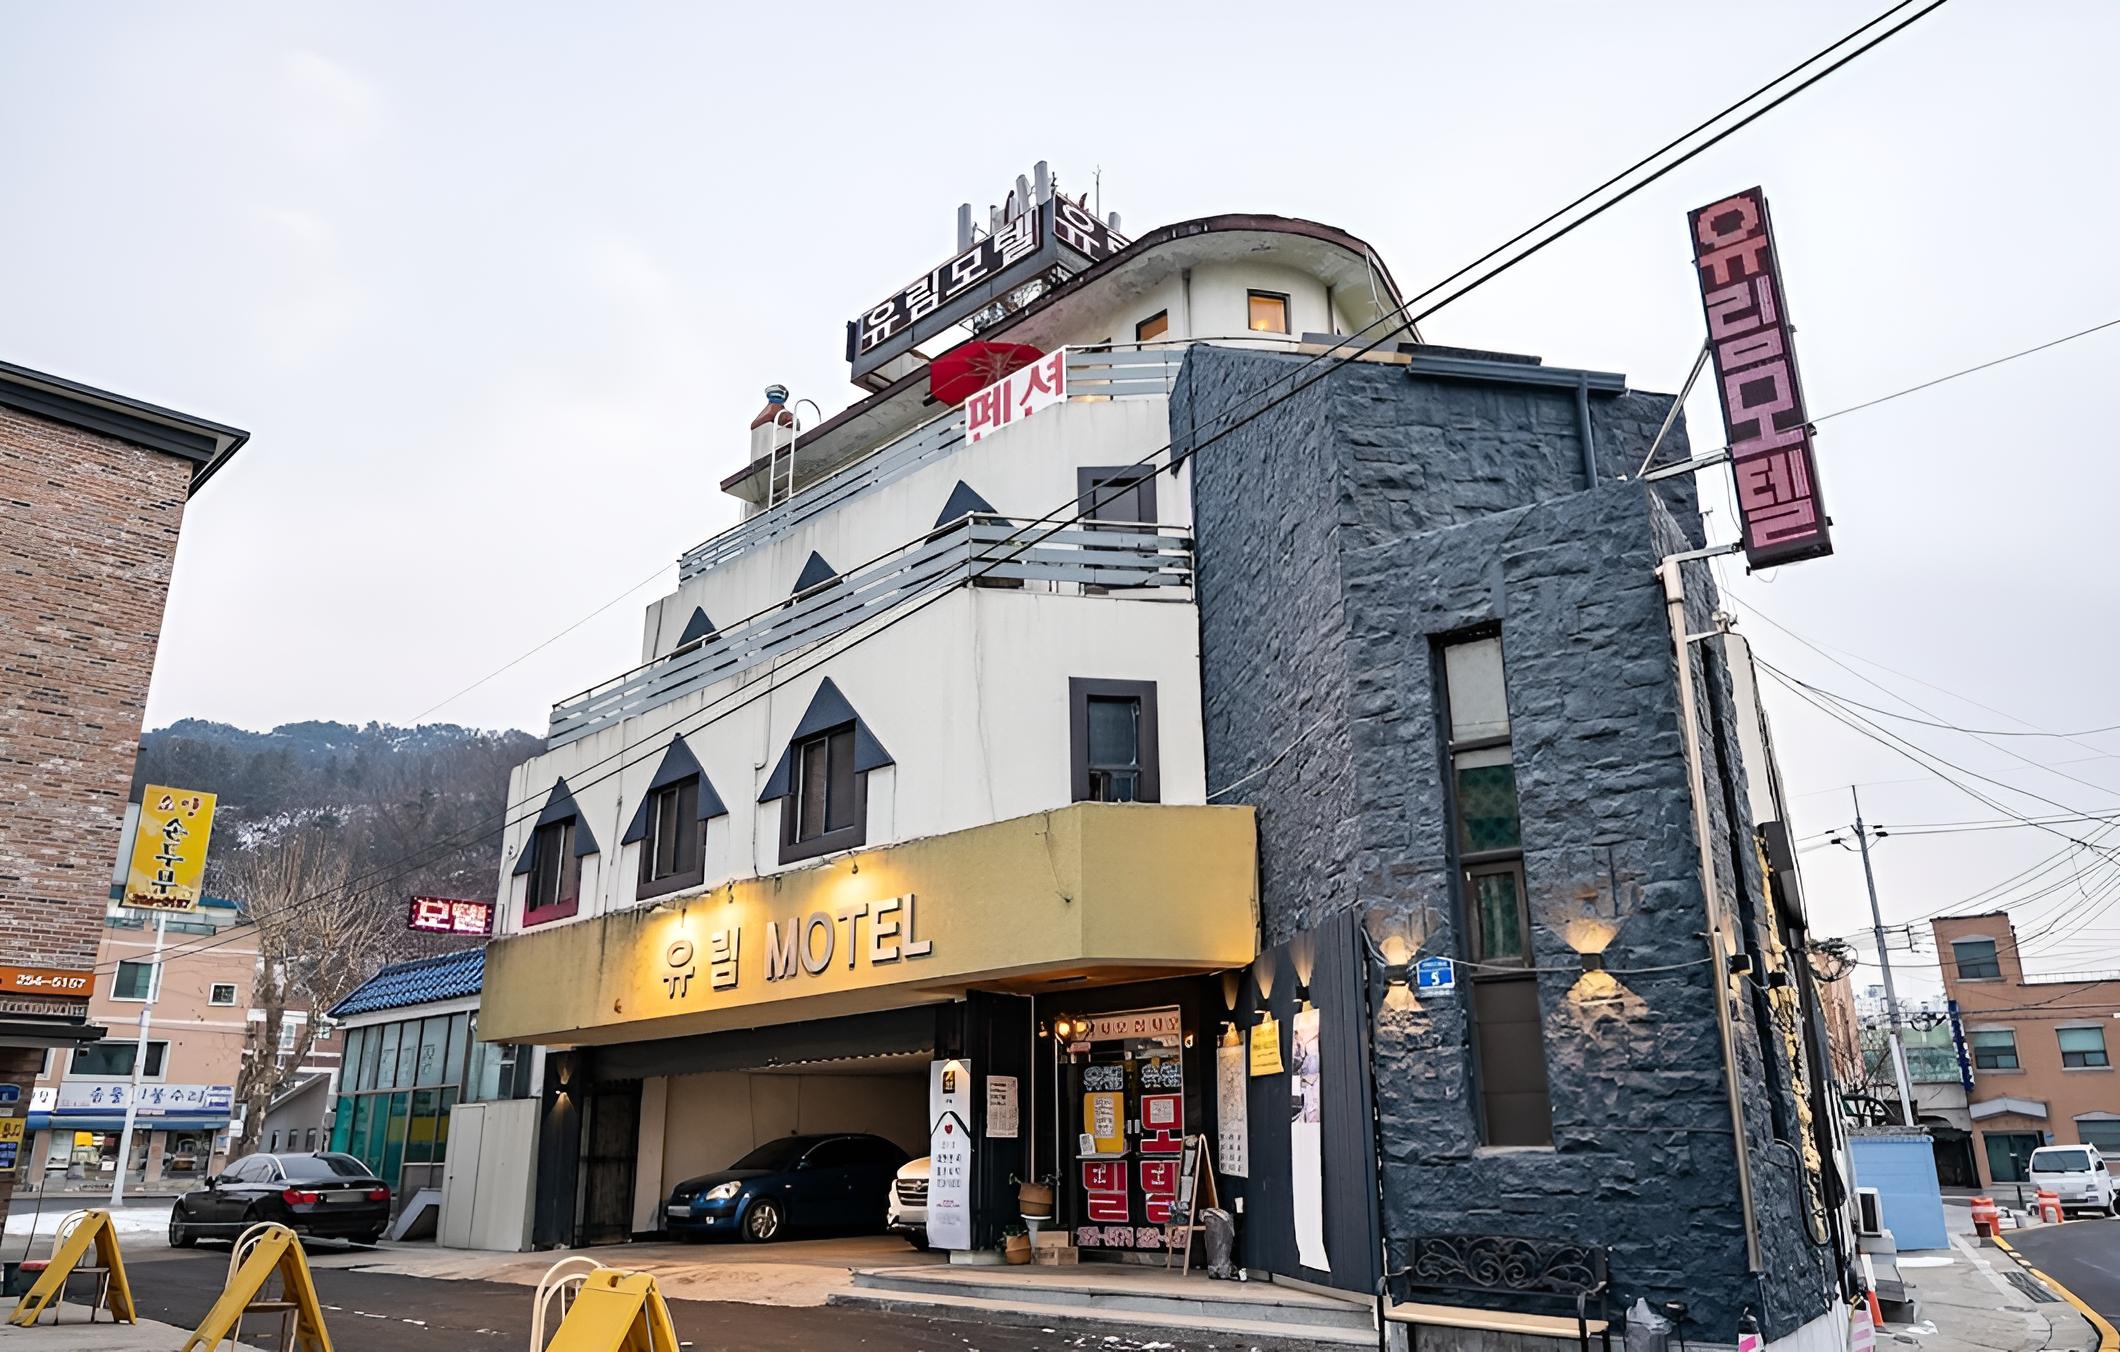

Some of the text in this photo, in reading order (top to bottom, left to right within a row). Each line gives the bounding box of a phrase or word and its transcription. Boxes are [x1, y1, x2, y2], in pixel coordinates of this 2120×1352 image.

[861, 205, 1039, 347] 유림모텔
[1698, 197, 1817, 548] 유림모텔
[663, 893, 933, 999] 유림 MOTEL
